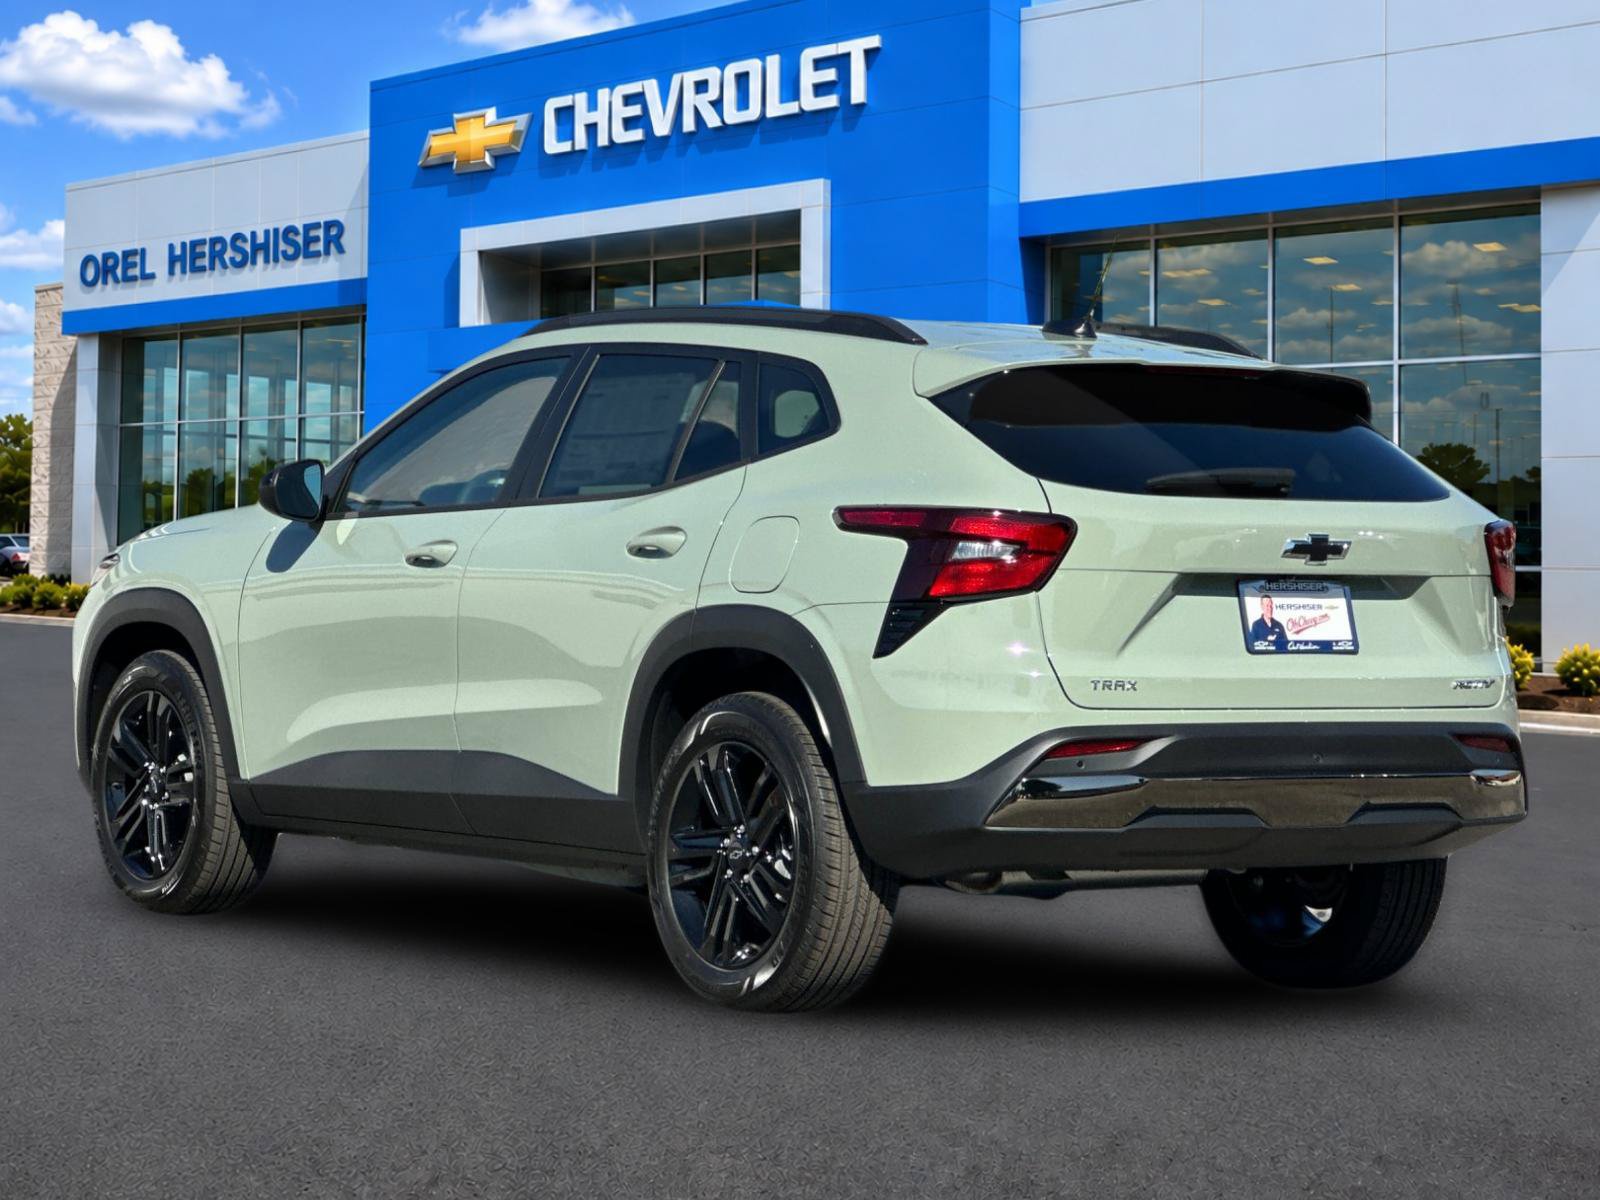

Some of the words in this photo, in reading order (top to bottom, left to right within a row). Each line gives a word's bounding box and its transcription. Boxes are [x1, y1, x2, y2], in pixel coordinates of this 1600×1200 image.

[544, 34, 882, 154] CHEVROLET
[80, 247, 156, 287] OREL
[168, 219, 346, 277] HERSHISER
[1275, 603, 1323, 611] HERSHISER
[1090, 680, 1138, 691] TRAX
